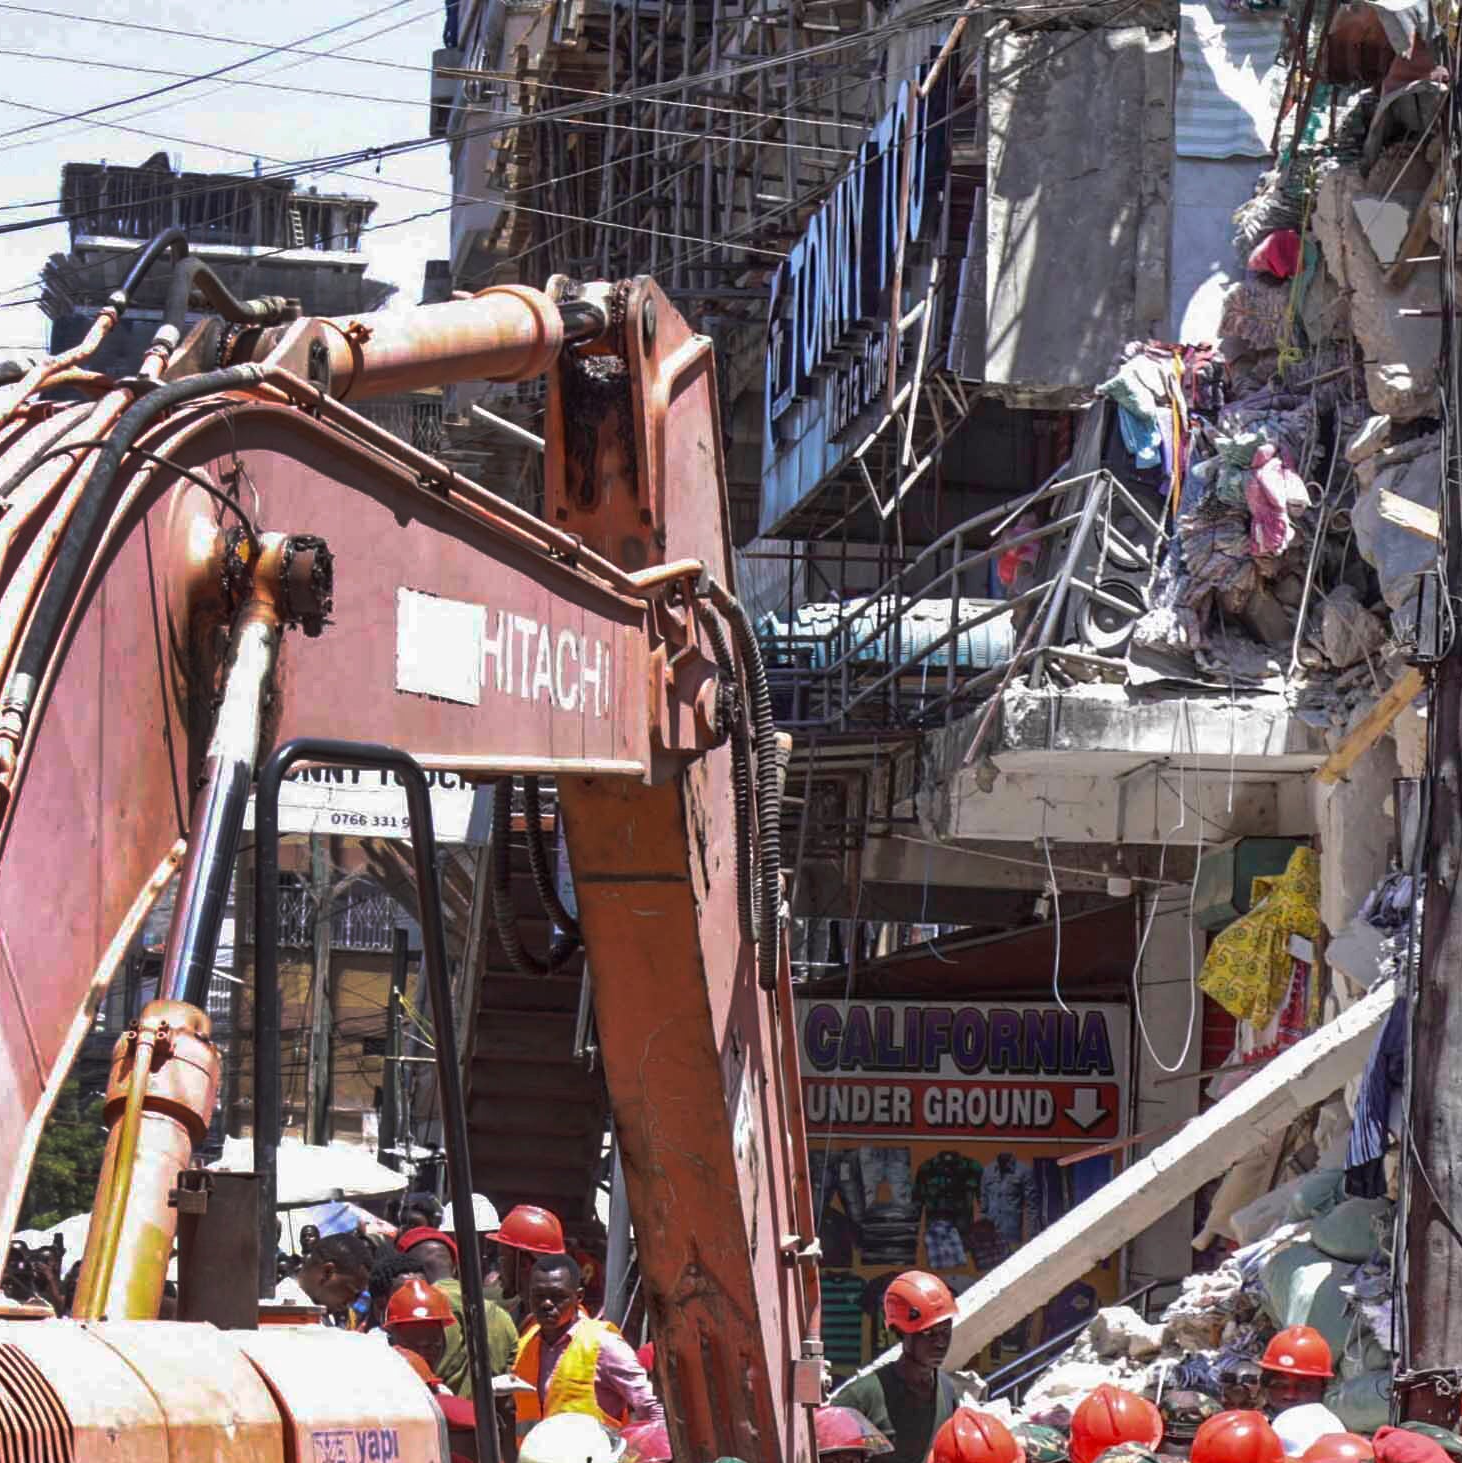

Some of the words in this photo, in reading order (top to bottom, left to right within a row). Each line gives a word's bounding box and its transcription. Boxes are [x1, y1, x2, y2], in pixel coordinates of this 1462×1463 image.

[480, 608, 610, 720] HITACHI
[330, 813, 367, 828] 0766
[372, 816, 397, 829] 331
[803, 1003, 1116, 1076] CALIFORNIA
[806, 1084, 914, 1126] UNDER
[922, 1086, 1056, 1128] GROUND
